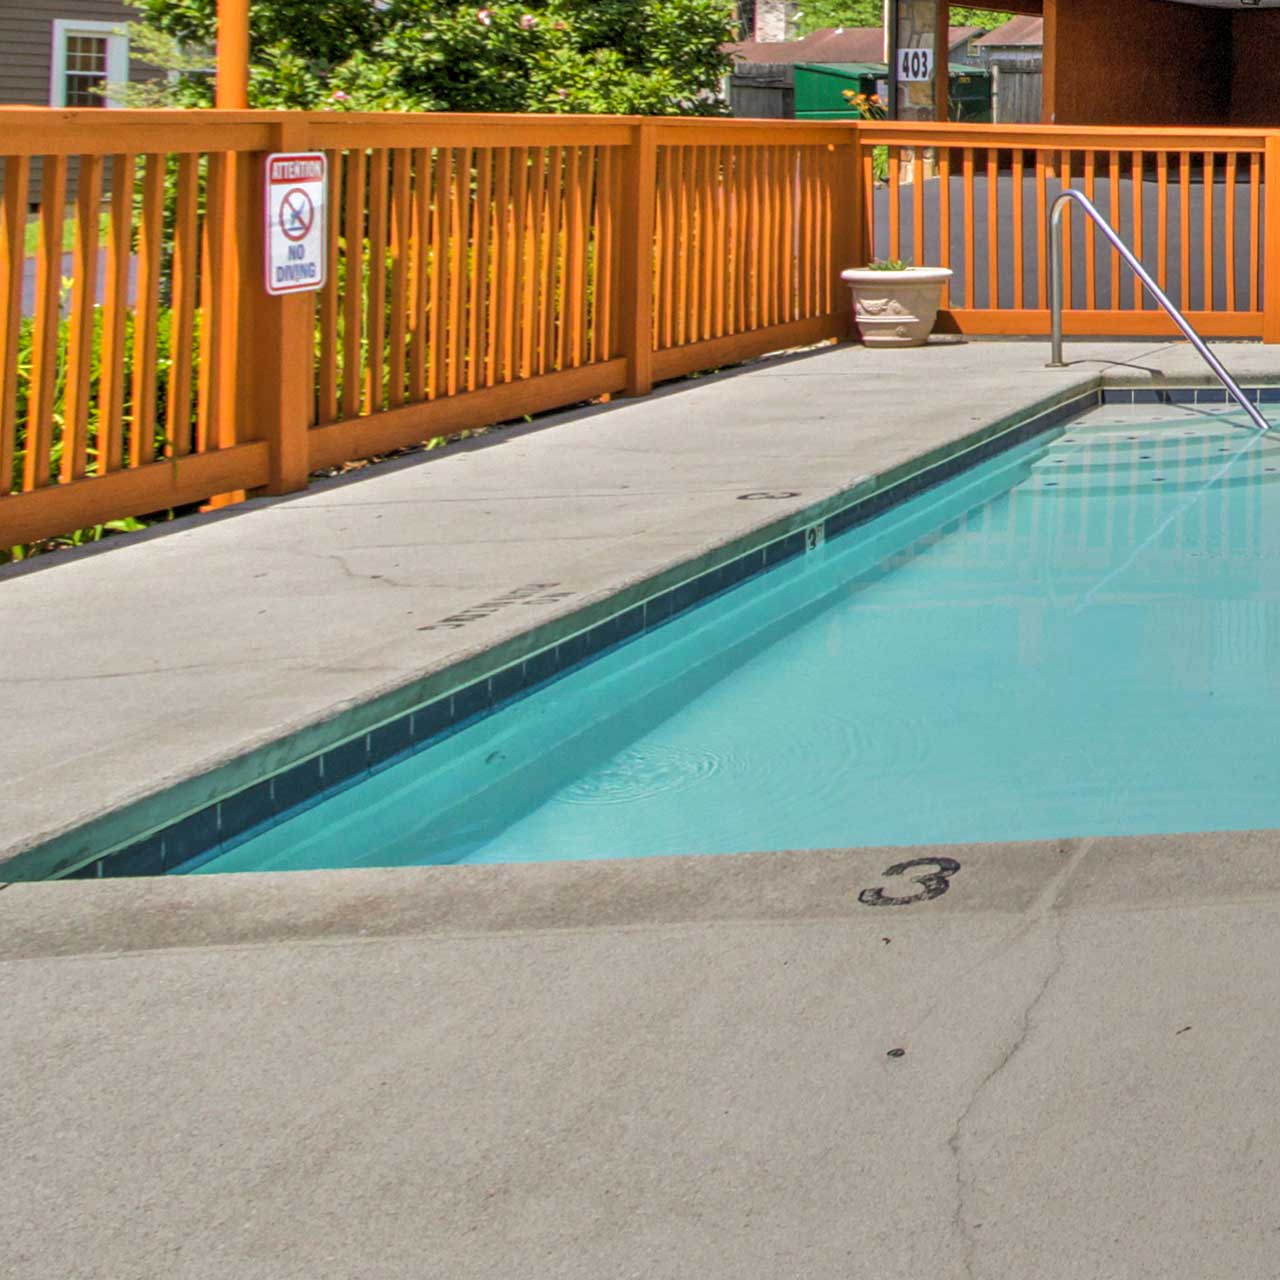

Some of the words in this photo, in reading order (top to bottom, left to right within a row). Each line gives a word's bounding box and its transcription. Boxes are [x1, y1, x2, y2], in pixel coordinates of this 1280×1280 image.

[902, 51, 928, 79] 403
[272, 160, 322, 180] ATTENTION
[288, 244, 305, 261] NO
[275, 262, 316, 282] DIVING
[857, 857, 961, 907] 3
